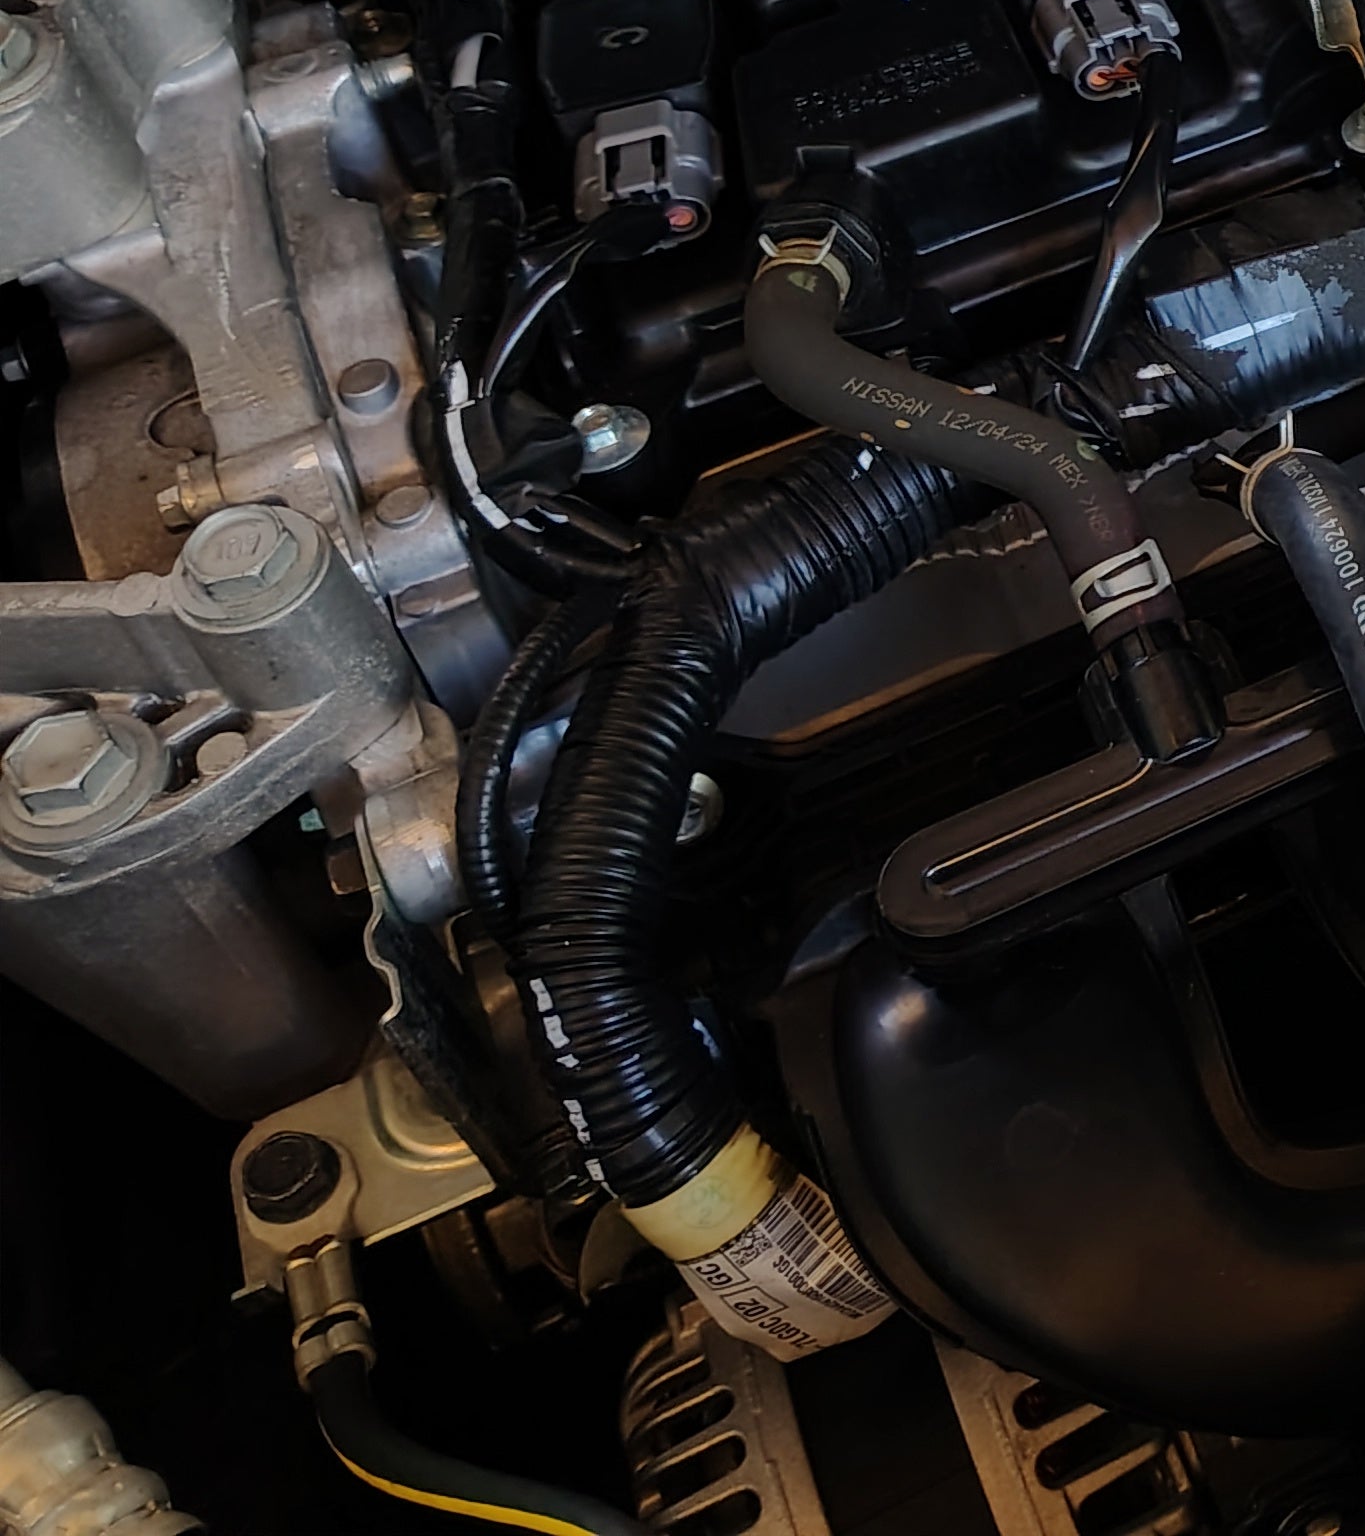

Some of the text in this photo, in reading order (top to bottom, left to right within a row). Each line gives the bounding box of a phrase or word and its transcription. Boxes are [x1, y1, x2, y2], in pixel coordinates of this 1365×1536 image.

[841, 376, 933, 419] NISSAN
[937, 408, 1049, 456] 12/04/24
[1048, 452, 1089, 490] MEX
[1320, 517, 1365, 591] 100624
[696, 1263, 733, 1287] GC
[734, 1297, 769, 1318] 02
